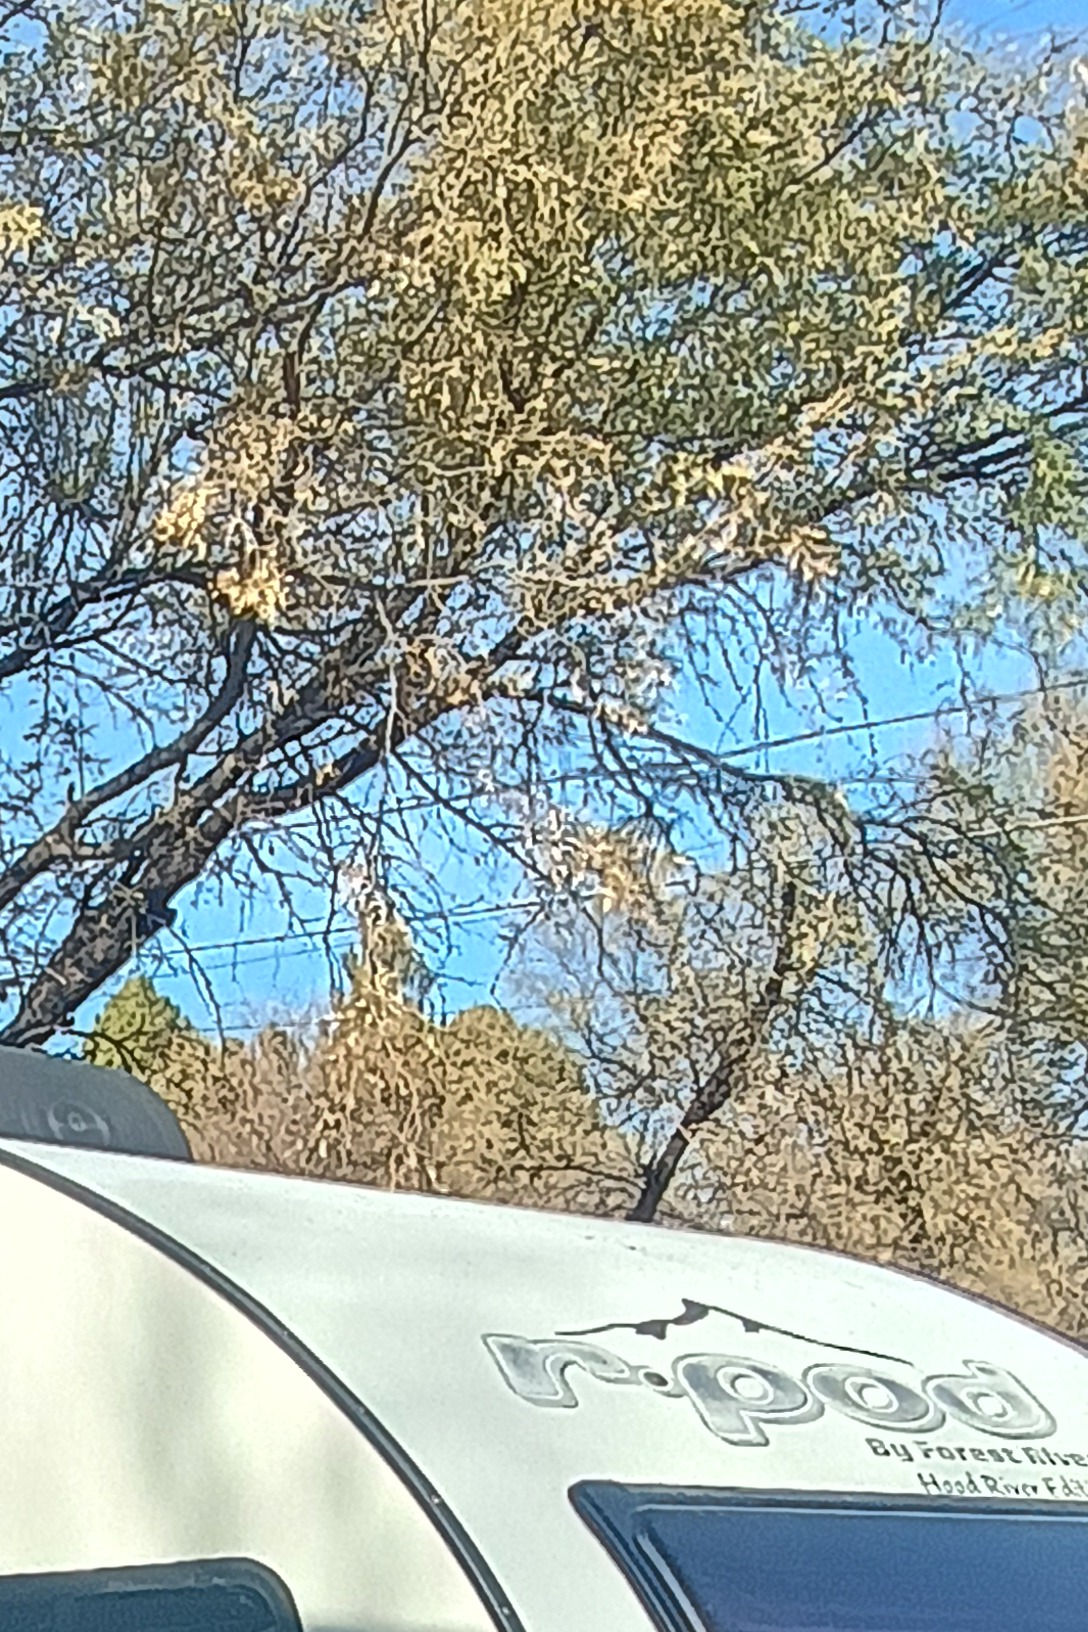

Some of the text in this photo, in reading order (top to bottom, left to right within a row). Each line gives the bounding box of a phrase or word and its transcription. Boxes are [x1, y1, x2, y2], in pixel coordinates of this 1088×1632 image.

[865, 1437, 1088, 1467] By Forest Rive
[917, 1472, 981, 1495] Hood
